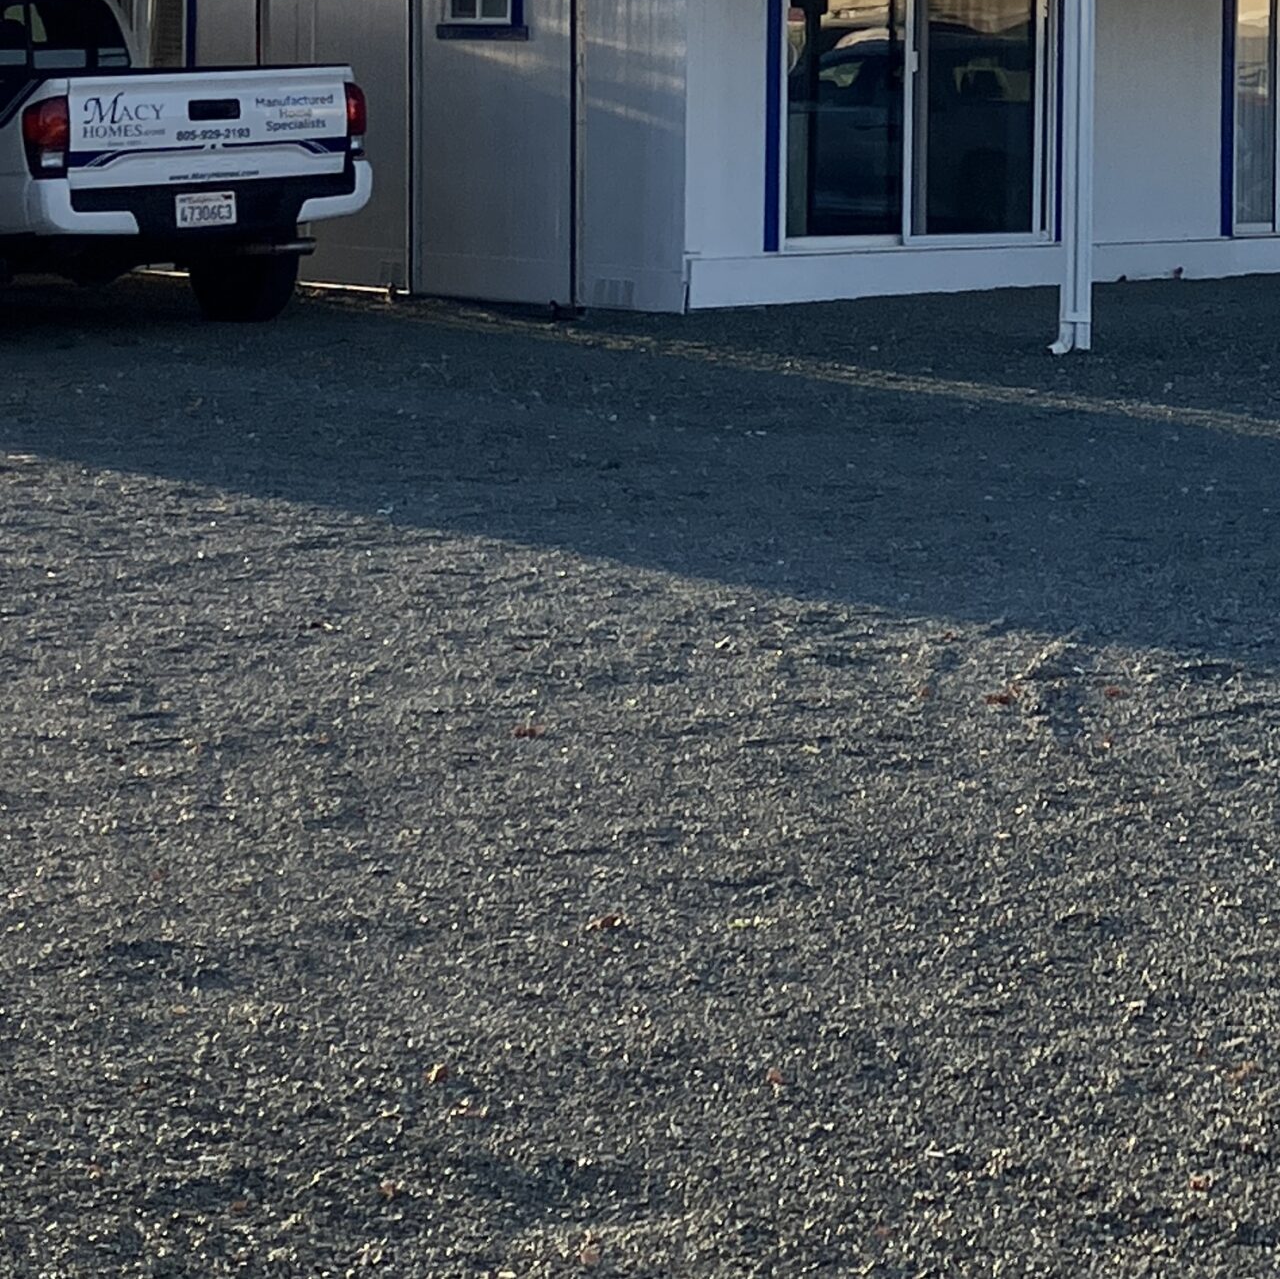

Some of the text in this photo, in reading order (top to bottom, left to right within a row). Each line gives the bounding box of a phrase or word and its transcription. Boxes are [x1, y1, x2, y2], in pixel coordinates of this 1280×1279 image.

[83, 91, 164, 124] MACY
[255, 94, 334, 108] Manufactured
[265, 119, 326, 132] Specialists
[176, 128, 251, 142] 805-929-2193
